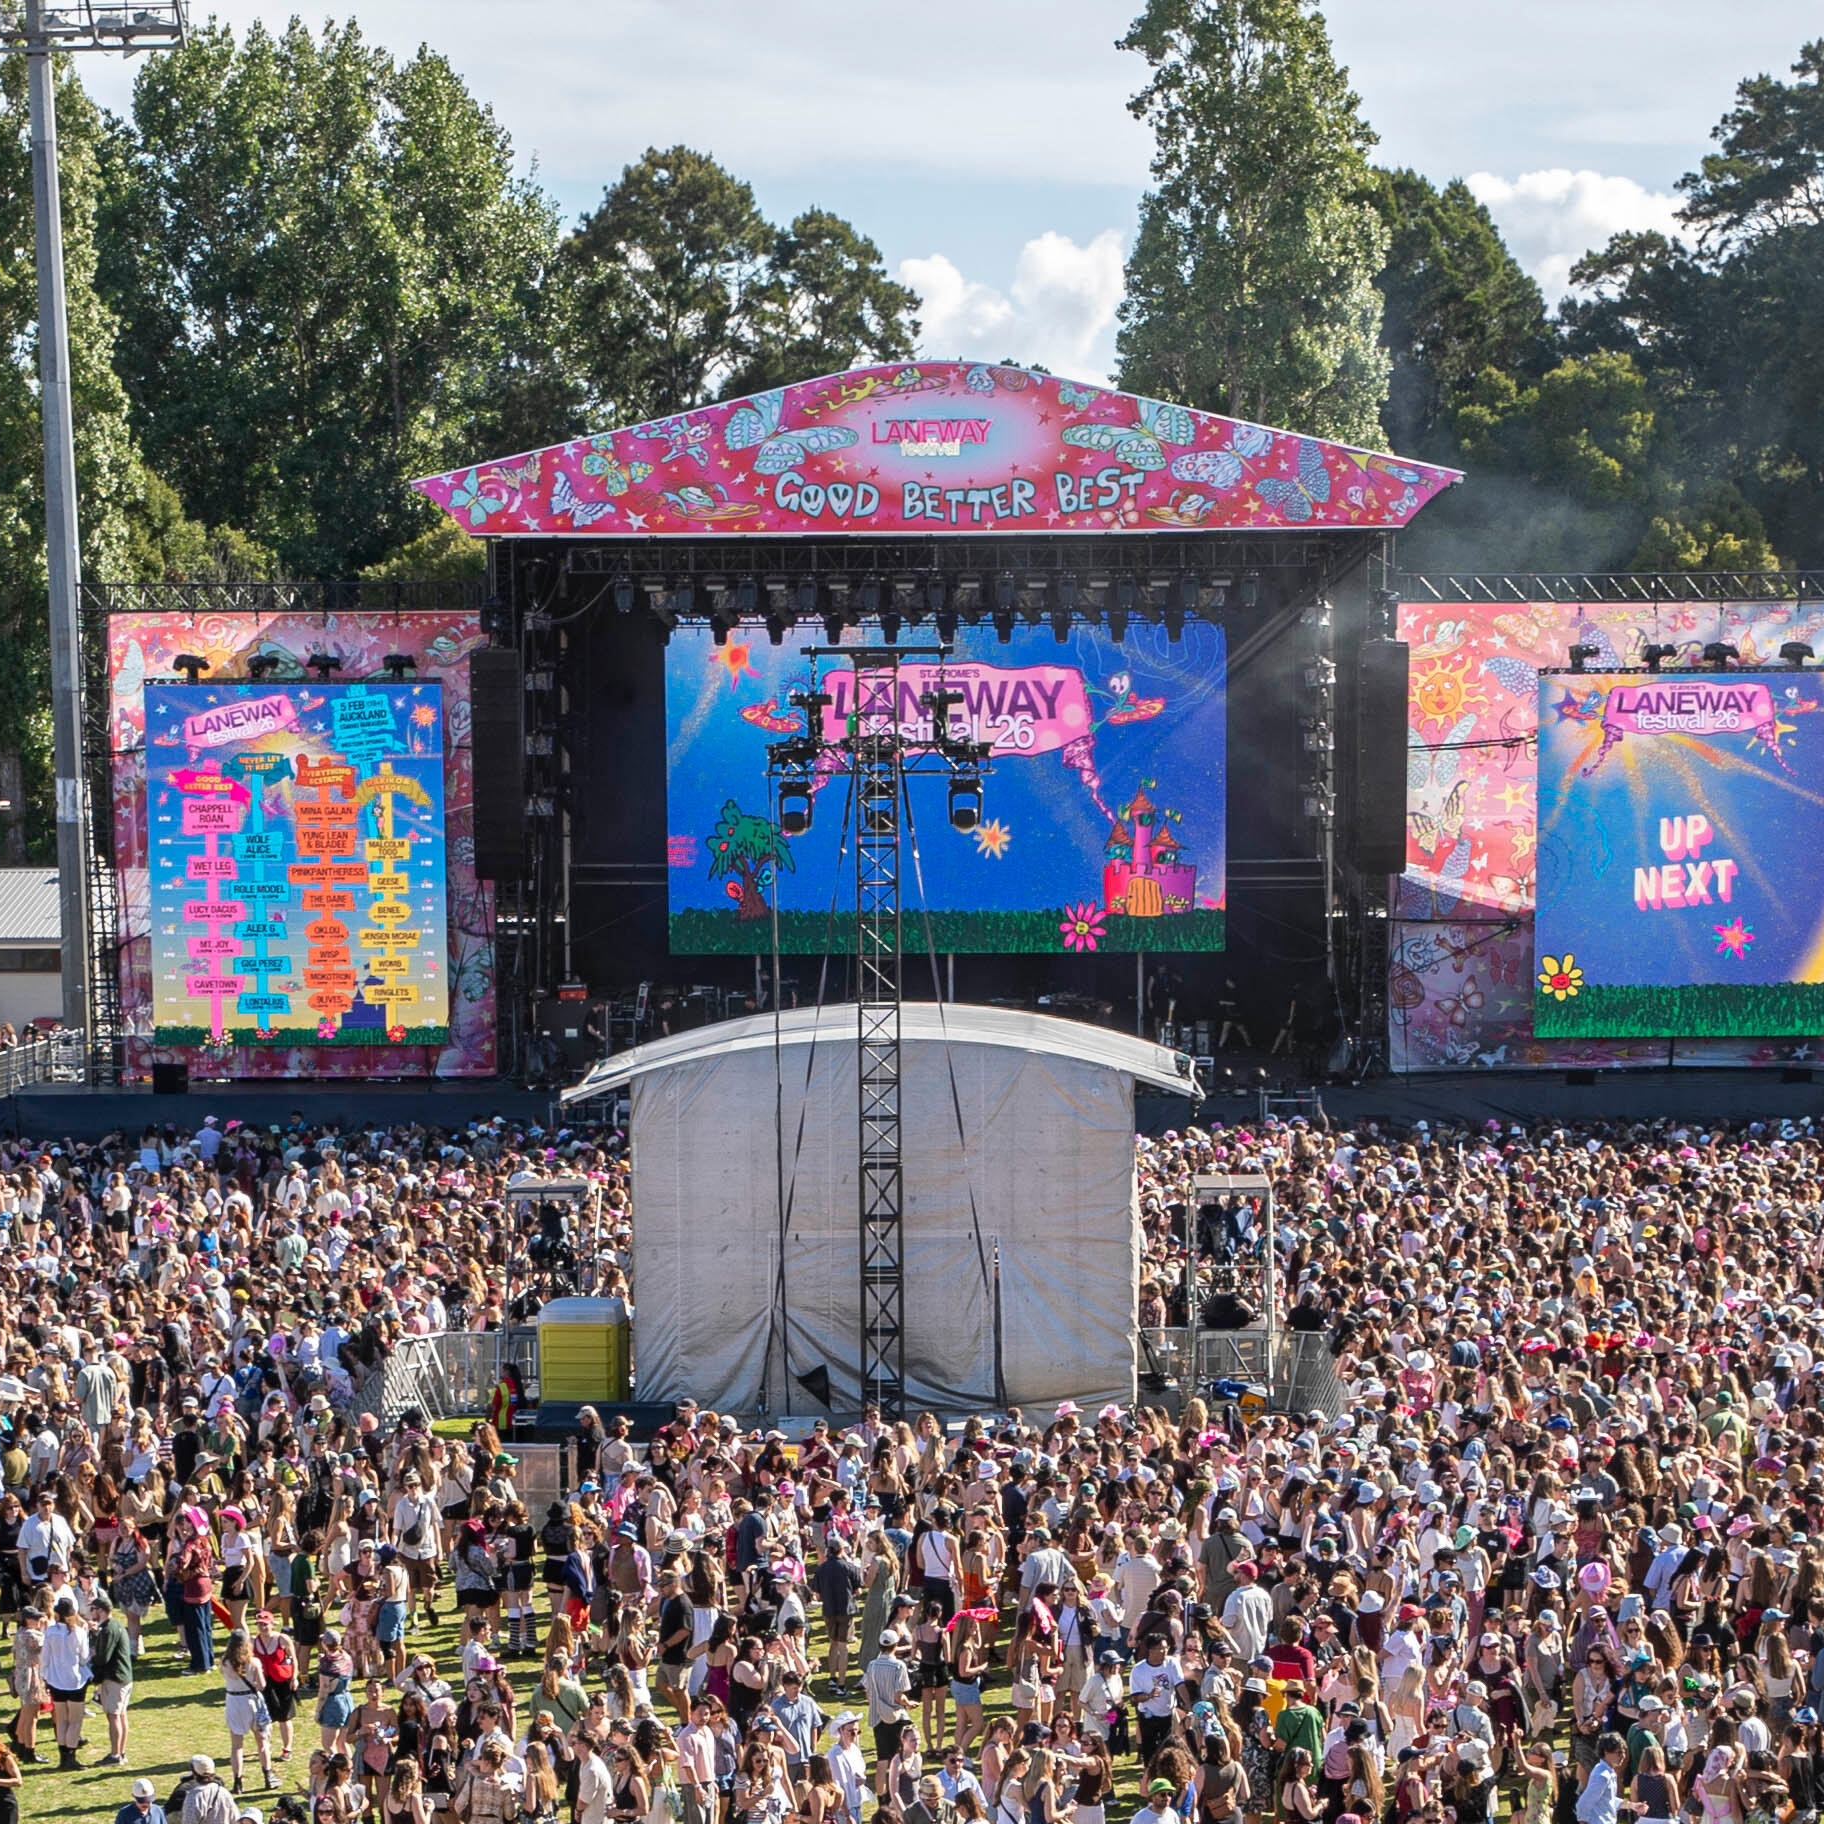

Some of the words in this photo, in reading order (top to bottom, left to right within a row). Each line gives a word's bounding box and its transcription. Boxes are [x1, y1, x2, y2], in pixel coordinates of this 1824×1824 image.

[871, 420, 993, 444] LANEWAY
[773, 471, 880, 519] GOOD
[902, 478, 1037, 523] BETTER
[1054, 467, 1145, 515] BEST
[348, 701, 365, 710] FEB
[1616, 691, 1758, 714] LANEWAY
[191, 701, 282, 735] LANEWAY
[339, 710, 387, 721] AUCKLAND
[1636, 710, 1705, 730] festival
[866, 713, 980, 745] festial
[188, 804, 233, 813] CHAPPELL
[325, 807, 353, 815] GALAN
[199, 814, 224, 823] ROAN
[246, 835, 271, 844] WOLF
[302, 831, 325, 839] YUNG
[327, 831, 349, 839] LEAN
[1660, 814, 1714, 862] UP
[246, 845, 271, 854] ALICE
[192, 861, 212, 870] WET
[214, 861, 231, 870] LEG
[291, 867, 365, 876] PINKPANTHERESS
[377, 877, 399, 885] GEESE
[1634, 858, 1739, 911] NEXT
[233, 885, 254, 893] ROLE
[257, 884, 286, 893] MODEL
[310, 895, 324, 903] THE
[326, 895, 347, 903] DARE
[189, 905, 208, 914] LUCY
[210, 905, 238, 914] DACUS
[378, 906, 401, 914] BENEE
[246, 924, 268, 932] ALEX
[314, 926, 340, 934] OKLOU
[362, 932, 390, 940] JENSEN
[215, 940, 230, 948] JOY
[379, 960, 402, 968] WOMB
[194, 981, 238, 989] CAVETOWN
[374, 988, 409, 996] RINGLETS
